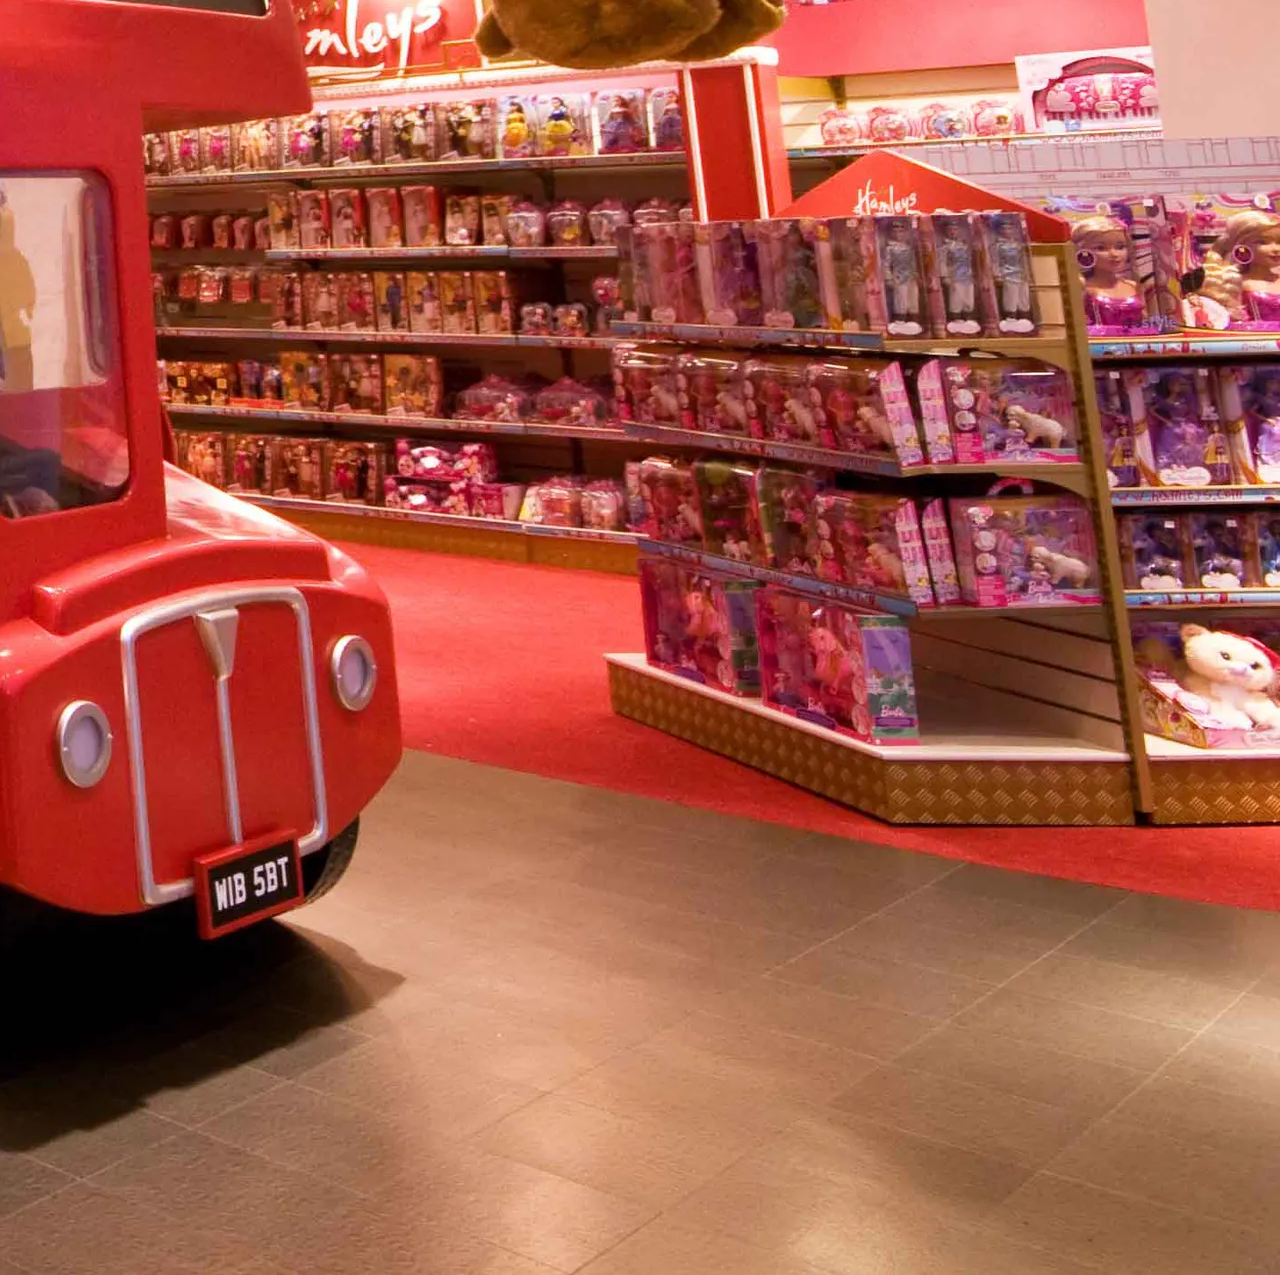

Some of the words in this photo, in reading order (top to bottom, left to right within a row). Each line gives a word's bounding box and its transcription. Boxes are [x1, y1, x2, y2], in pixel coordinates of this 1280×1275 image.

[852, 178, 918, 215] Hamleys
[214, 872, 247, 911] WIB
[253, 856, 289, 897] 5BT
